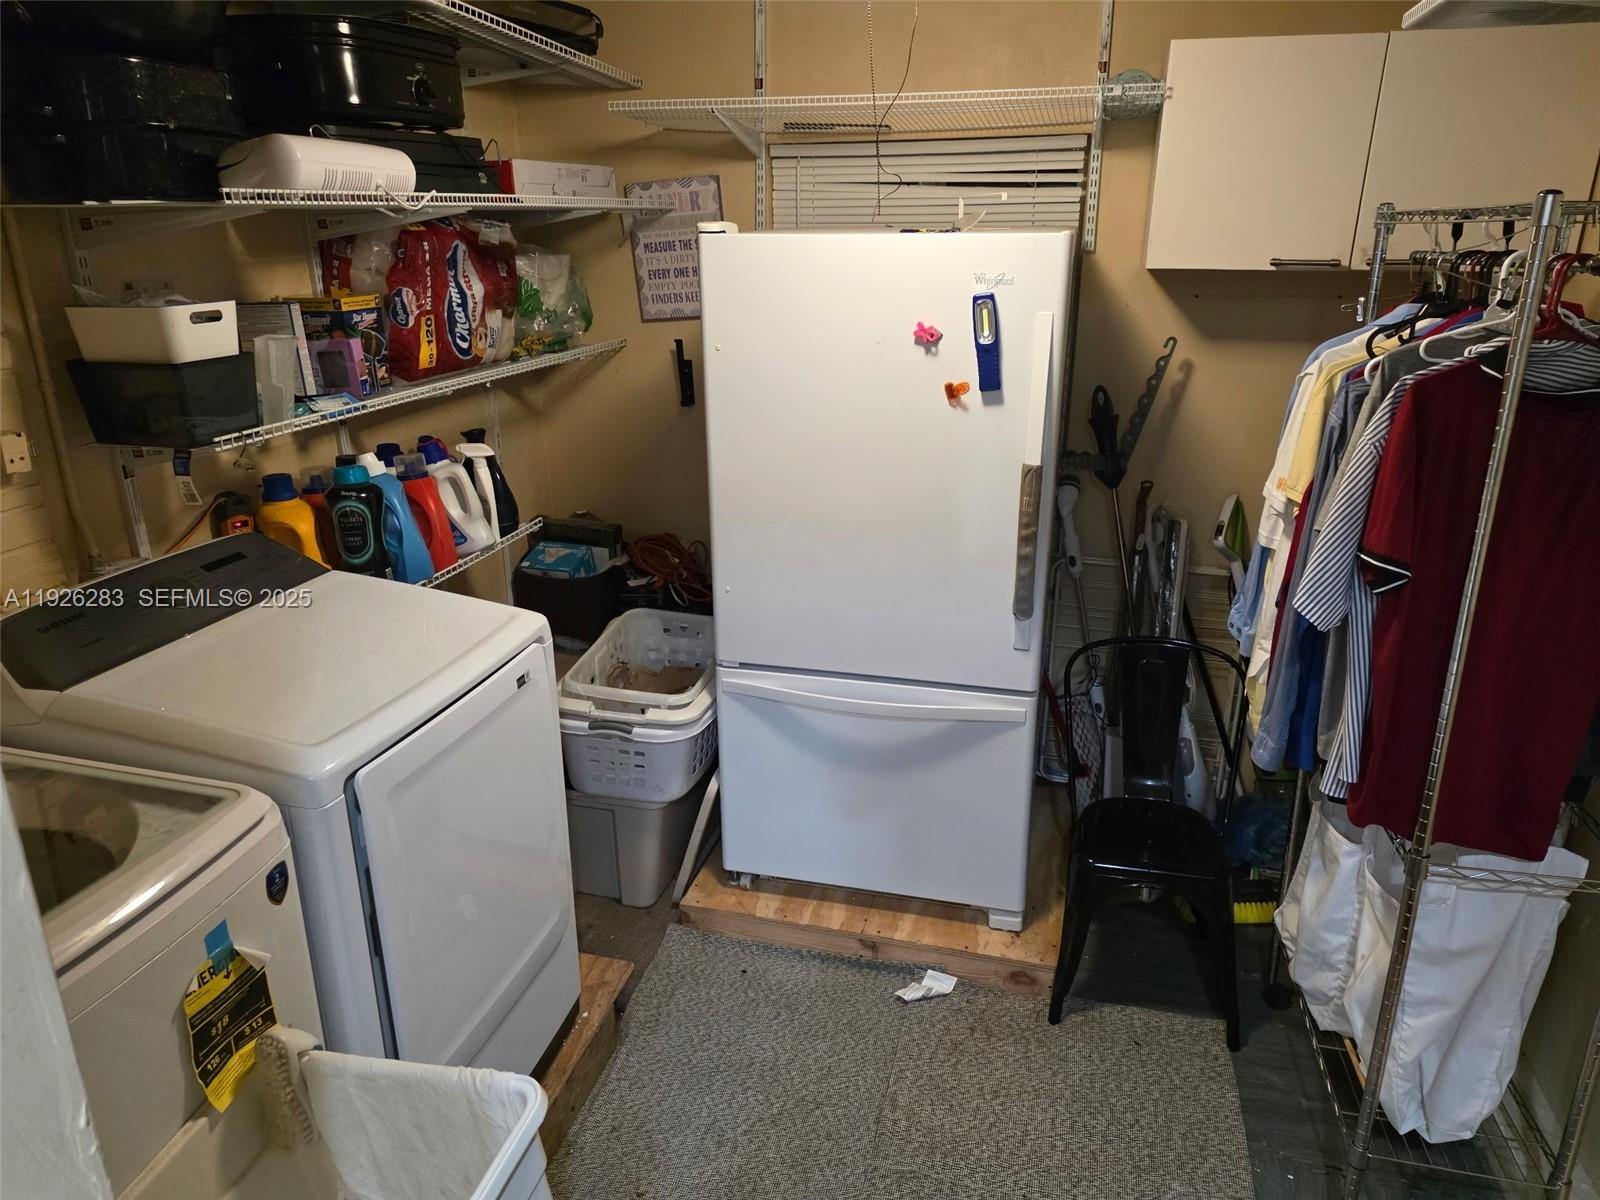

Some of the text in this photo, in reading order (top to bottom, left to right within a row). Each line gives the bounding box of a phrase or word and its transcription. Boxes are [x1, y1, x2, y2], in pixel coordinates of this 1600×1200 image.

[643, 239, 677, 254] MEASURE
[678, 238, 693, 251] THE
[648, 267, 671, 280] EVERY
[673, 266, 690, 278] ONE
[974, 273, 1014, 289] Whirlpool
[648, 281, 676, 291] EMPTY
[651, 291, 699, 305] FINDERS KEE
[448, 269, 470, 349] Charmin
[37, 612, 86, 633] SAMSUNG
